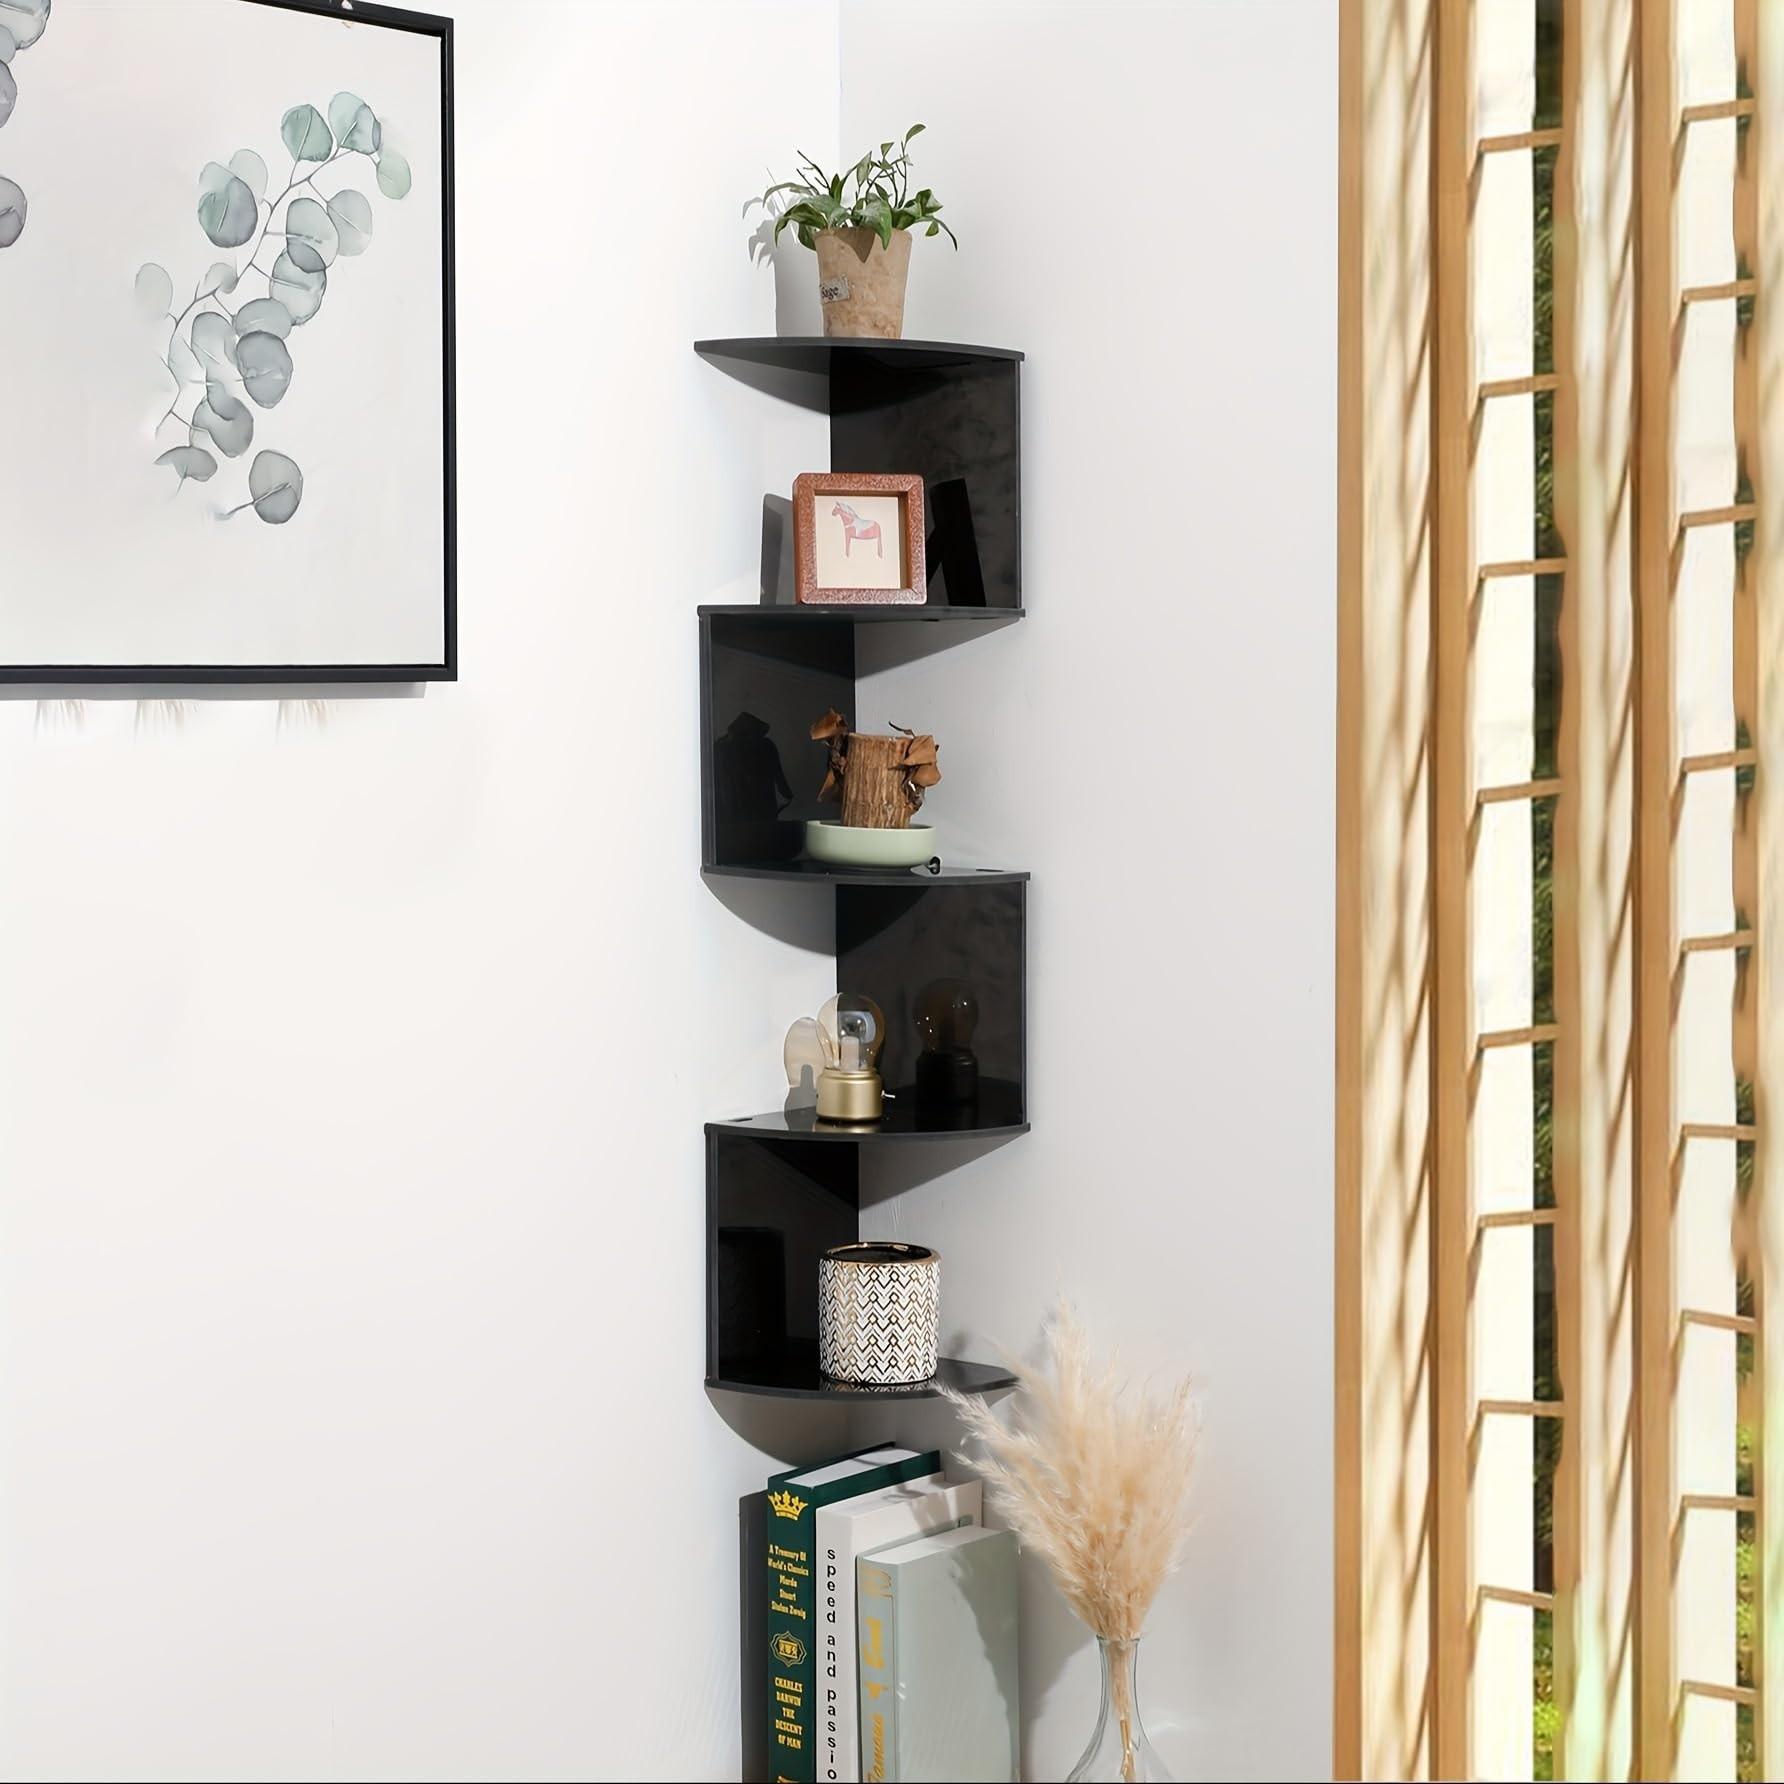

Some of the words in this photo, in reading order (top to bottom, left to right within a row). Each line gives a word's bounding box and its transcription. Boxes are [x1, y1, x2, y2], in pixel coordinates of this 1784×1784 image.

[769, 1544, 775, 1555] A
[774, 1545, 799, 1561] Treasury
[768, 1557, 787, 1571] World's
[787, 1563, 809, 1576] Classics
[827, 1549, 837, 1623] speed
[789, 1605, 806, 1620] Zweig
[827, 1634, 837, 1678] and
[775, 1677, 803, 1693] CHARLES
[776, 1691, 801, 1706] DARWIN
[782, 1707, 795, 1719] THE
[775, 1719, 802, 1735] DESCENT
[827, 1689, 838, 1780] passio
[778, 1734, 787, 1745] OF
[786, 1736, 801, 1749] MAN
